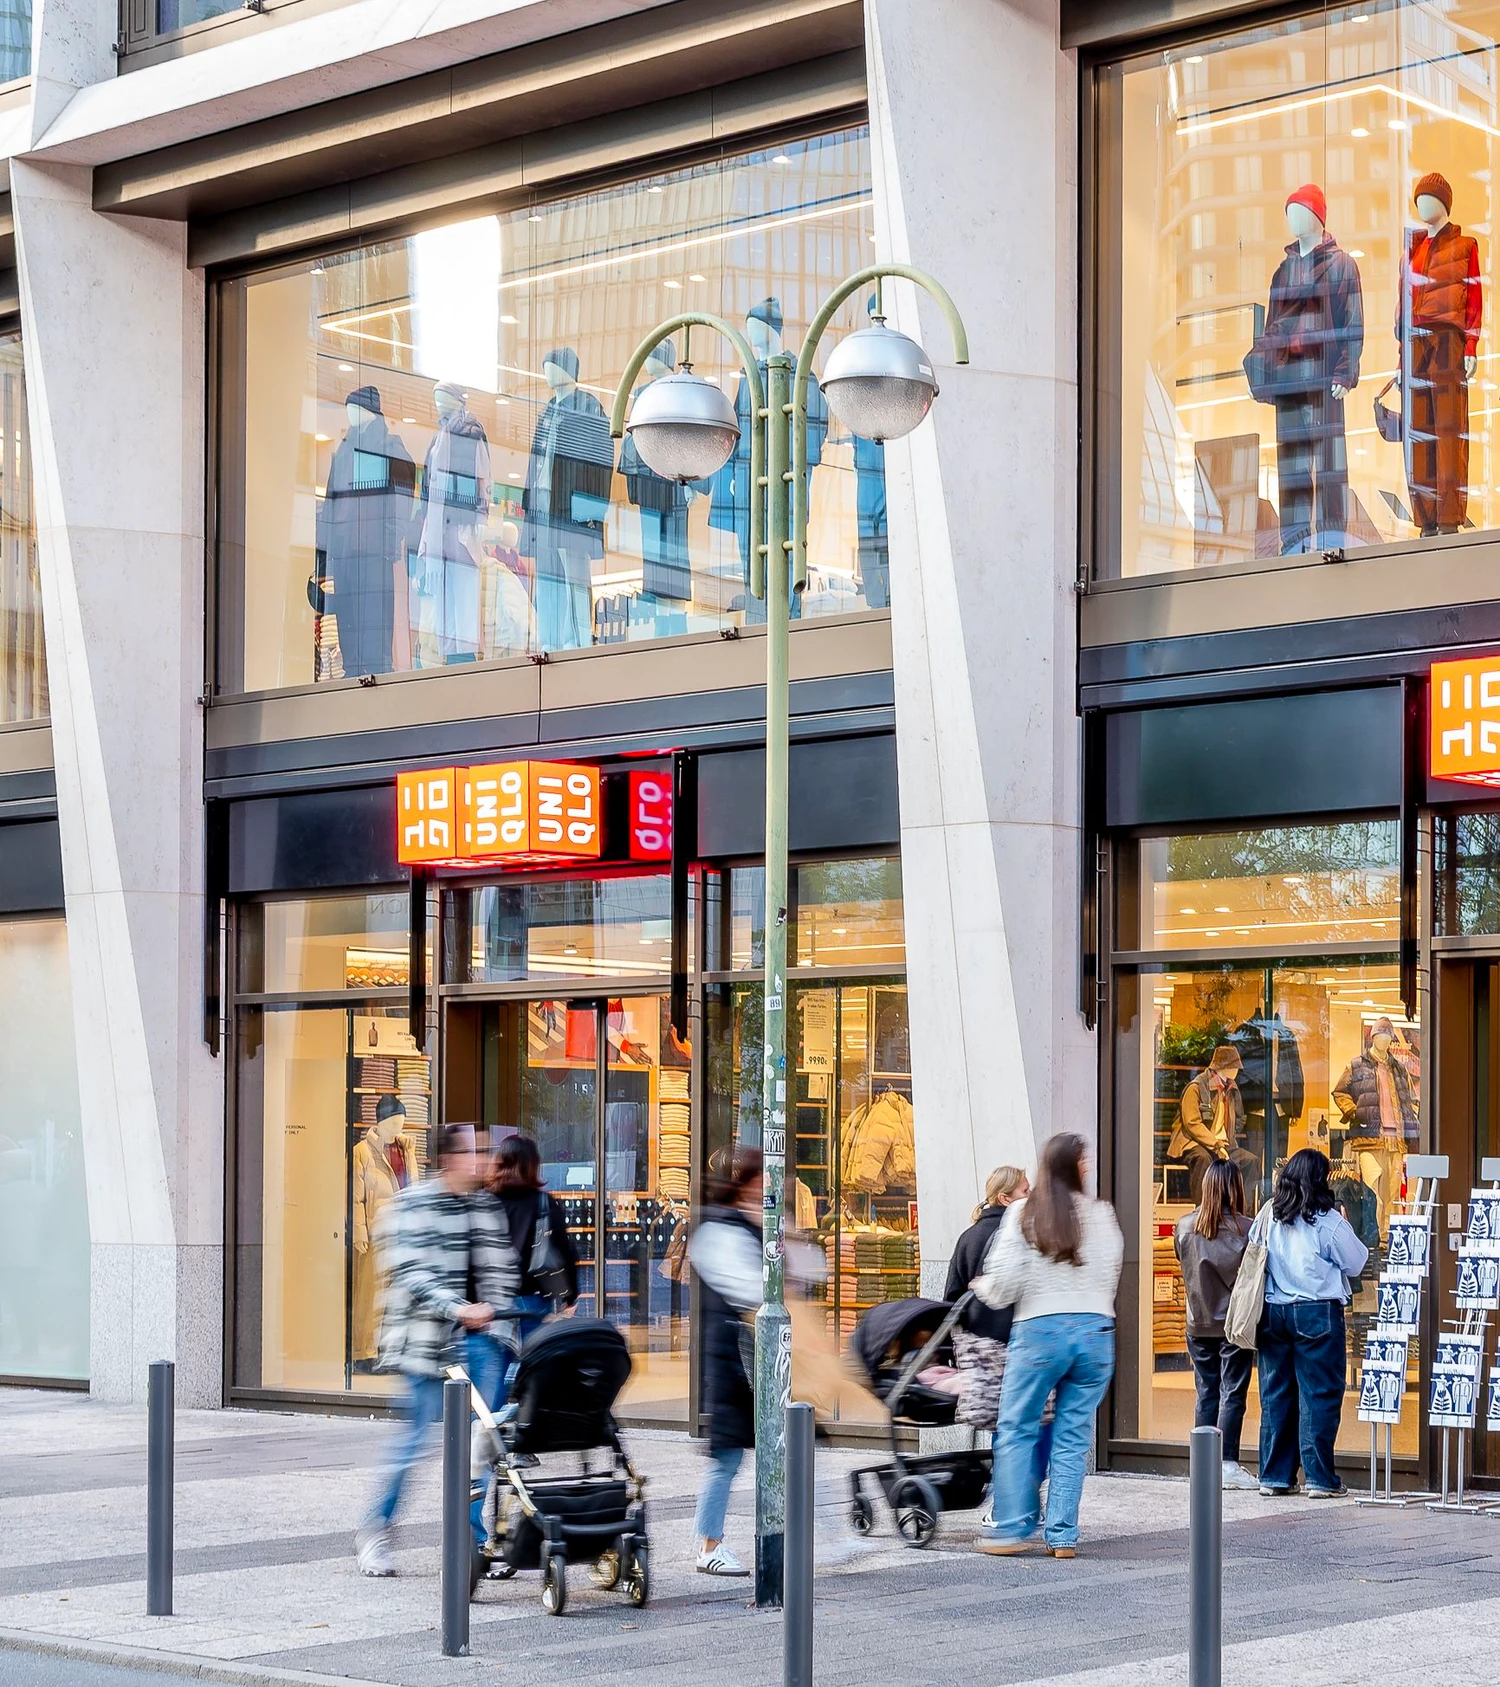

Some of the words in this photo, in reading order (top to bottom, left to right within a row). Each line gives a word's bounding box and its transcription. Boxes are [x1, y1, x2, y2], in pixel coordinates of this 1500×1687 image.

[476, 779, 498, 845] UNI
[500, 771, 526, 844] QLO
[538, 776, 563, 843] UNI
[567, 773, 596, 845] QLO
